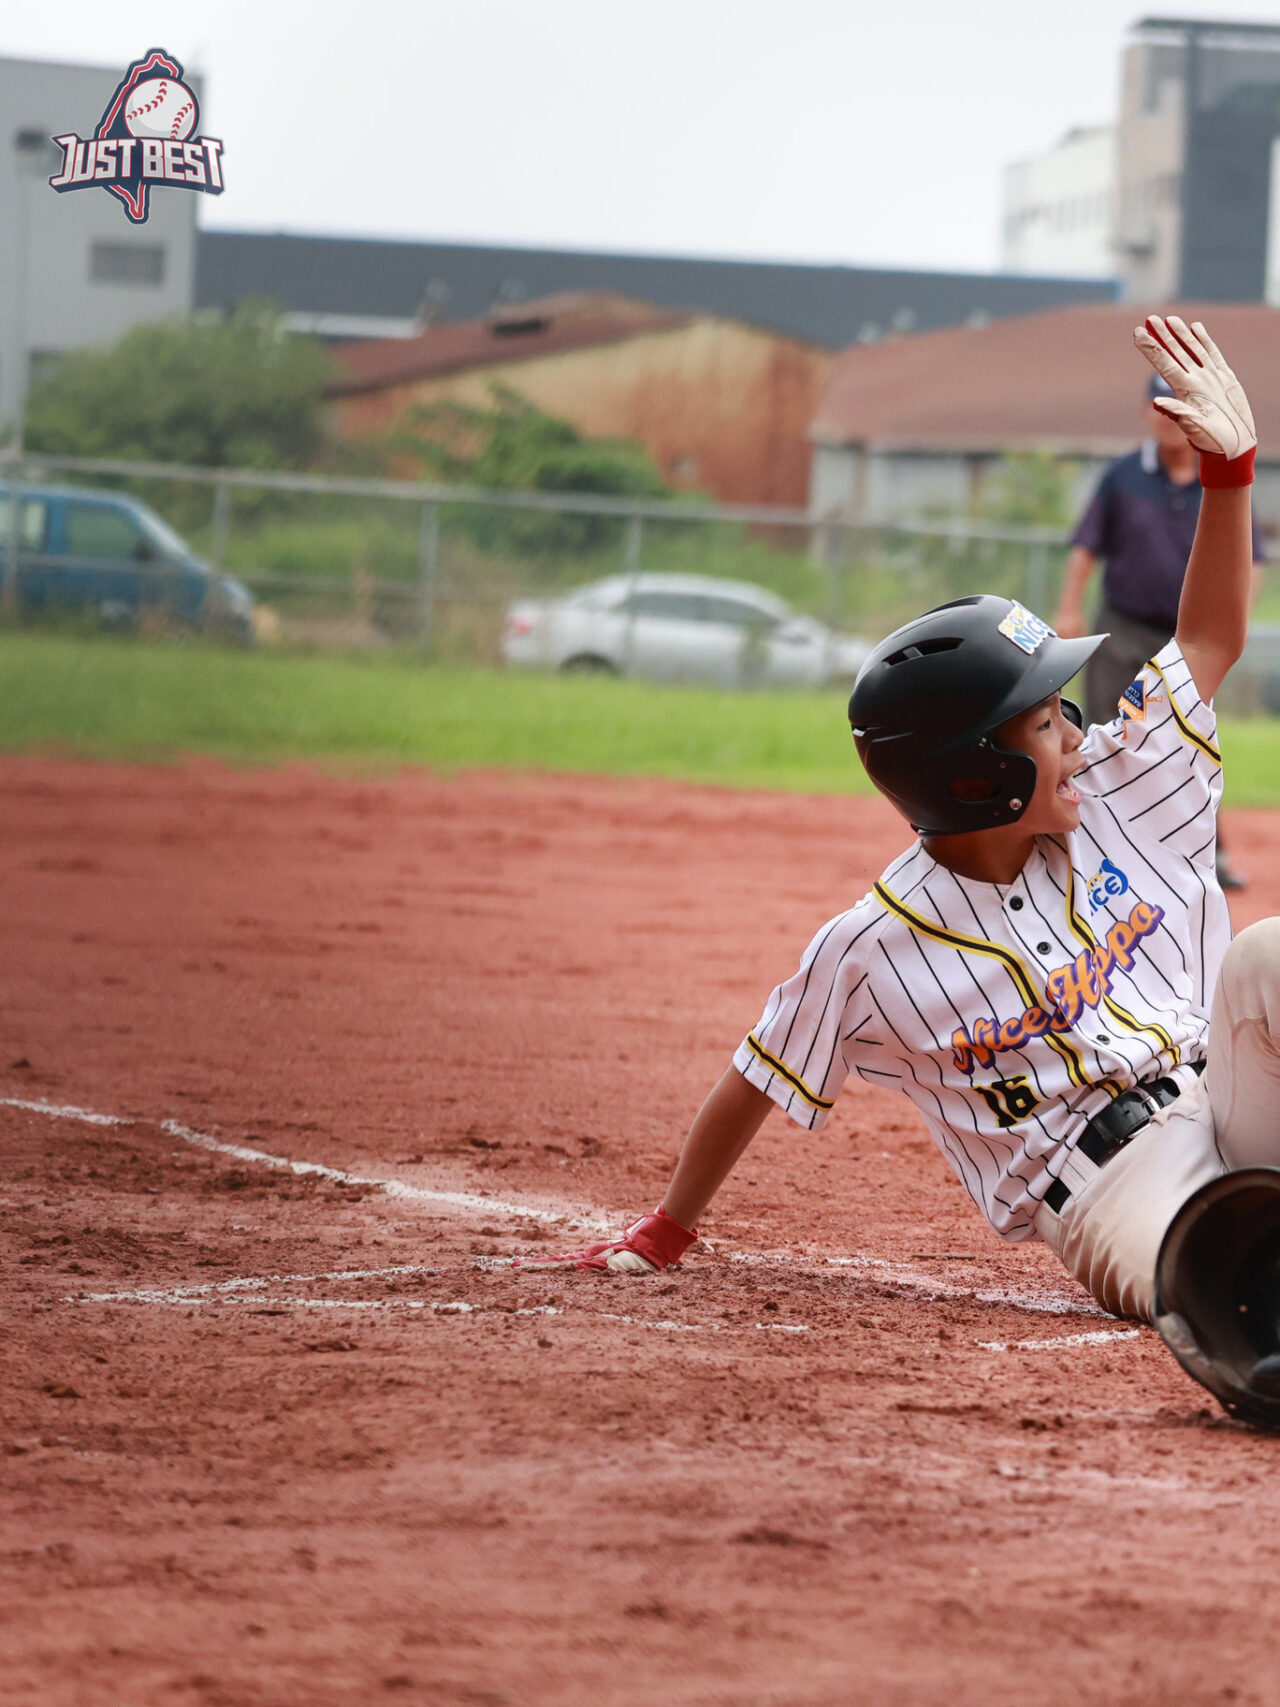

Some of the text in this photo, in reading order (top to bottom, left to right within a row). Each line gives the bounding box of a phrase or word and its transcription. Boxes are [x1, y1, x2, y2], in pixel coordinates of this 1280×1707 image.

[1089, 873, 1123, 917] ICE
[951, 901, 1166, 1075] Nice Hppo
[971, 1074, 1042, 1128] 16
